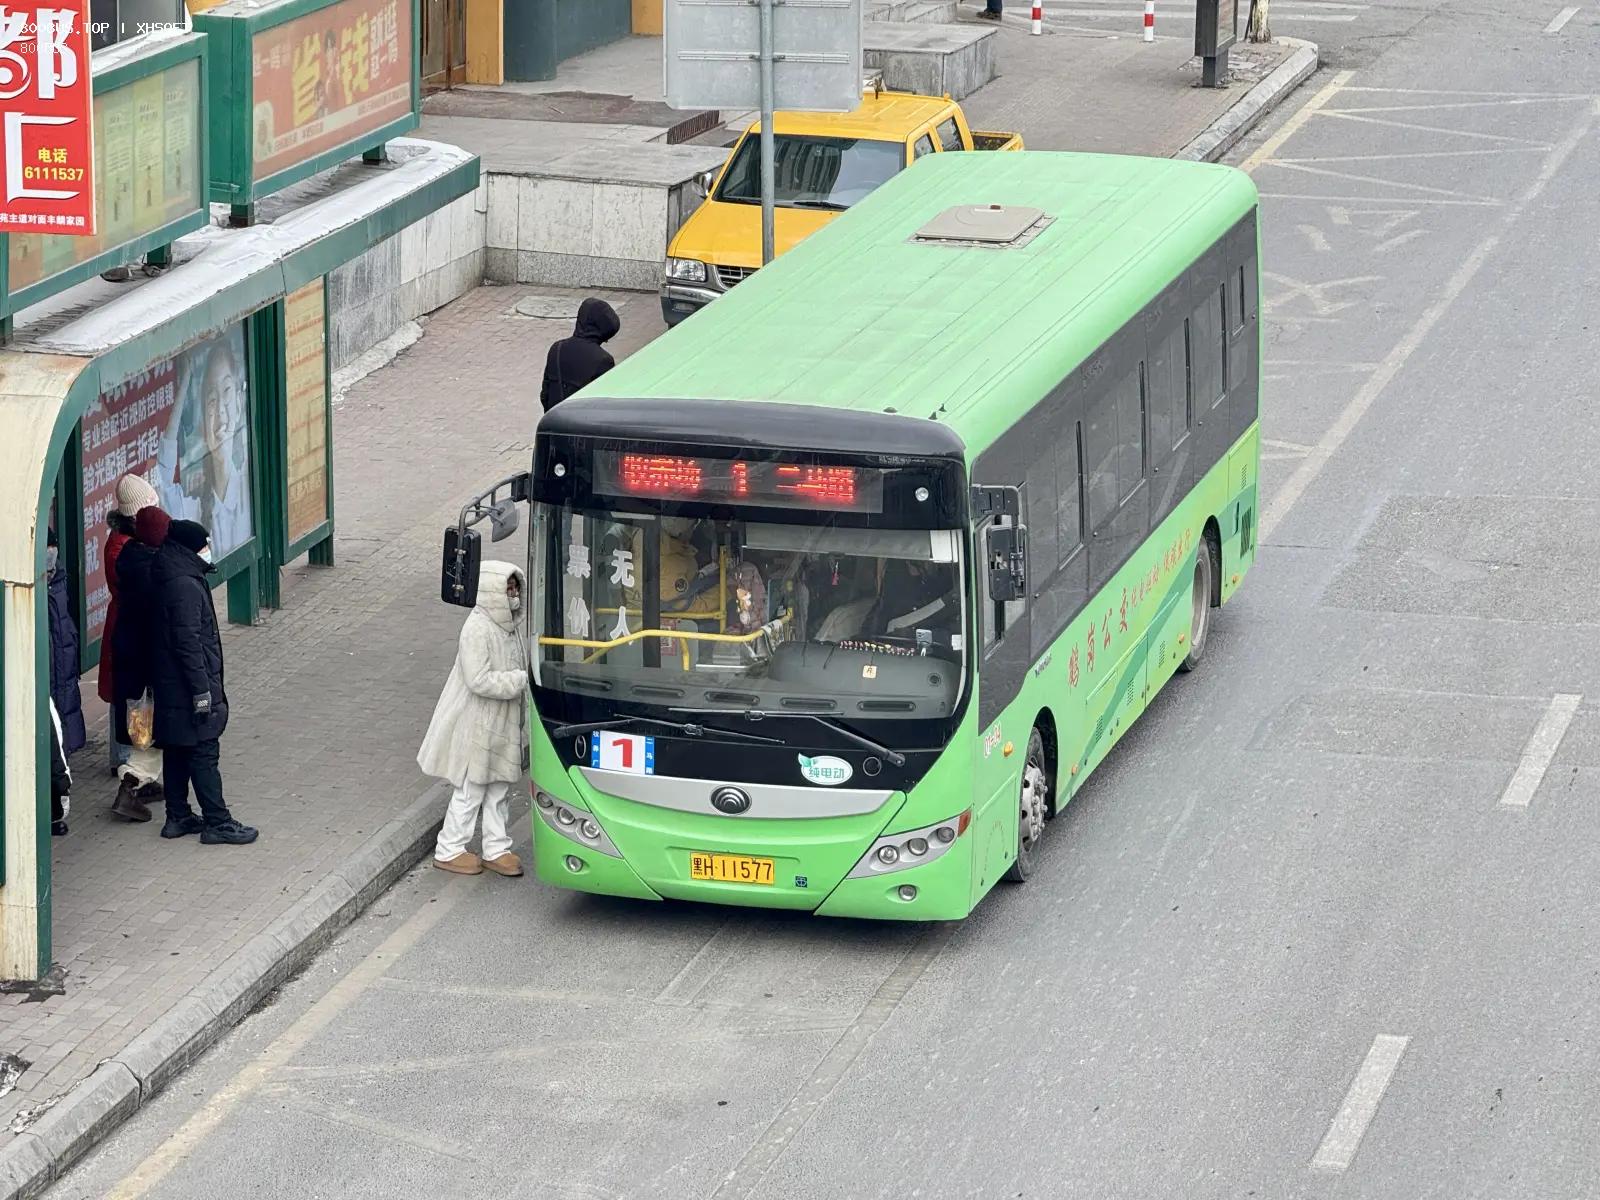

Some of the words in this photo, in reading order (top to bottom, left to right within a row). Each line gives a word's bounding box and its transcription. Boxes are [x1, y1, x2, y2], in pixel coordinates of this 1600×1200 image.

[38, 147, 68, 164] 电话
[24, 166, 84, 181] 6111537
[732, 461, 748, 494] 1
[612, 738, 633, 769] 1
[808, 765, 845, 779] 纯电动
